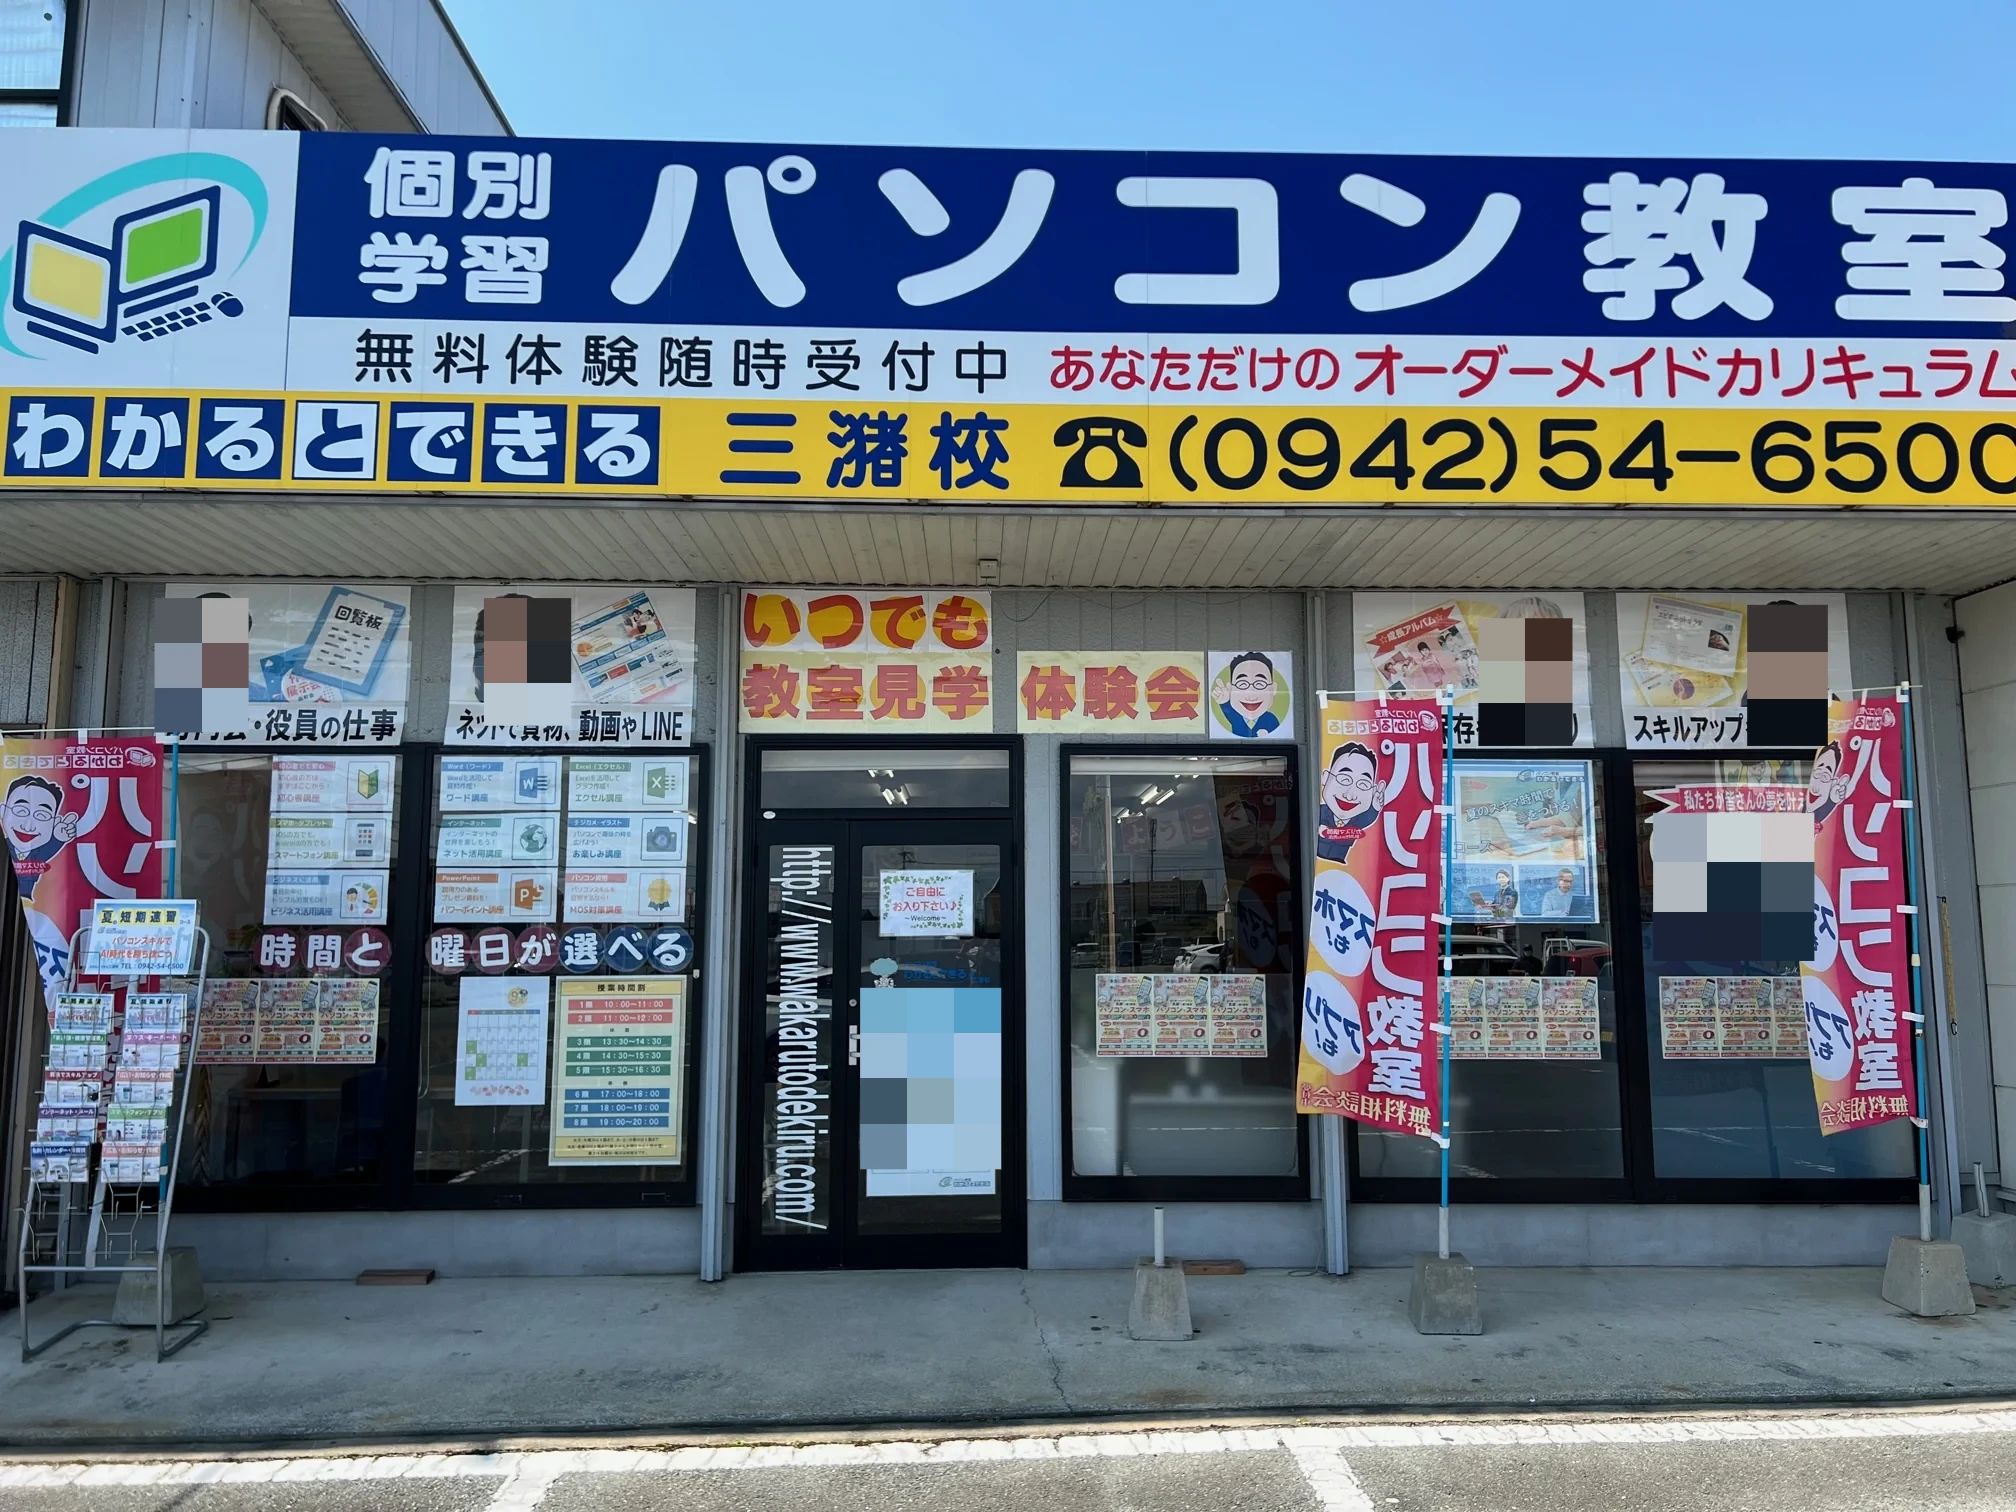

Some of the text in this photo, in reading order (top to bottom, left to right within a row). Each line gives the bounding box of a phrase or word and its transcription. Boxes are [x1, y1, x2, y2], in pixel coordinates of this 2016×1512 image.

[364, 146, 552, 220] 個別
[610, 155, 2016, 322] パソコン教室
[358, 231, 550, 305] 学習
[355, 328, 1007, 394] 無料体験随時受付中
[12, 403, 651, 478] わかるとできる
[335, 605, 384, 630] 回覧板
[743, 592, 988, 650] いつでも
[743, 664, 989, 720] 教室見学
[1021, 664, 1201, 721] 体験会
[1633, 712, 1748, 744] スキルアップ
[446, 794, 489, 802] ワード講座
[575, 794, 623, 802] エクセル講座
[443, 850, 502, 859] ネット活用講座
[572, 850, 622, 859] お楽しみ講座
[906, 887, 946, 897] ご自由に
[260, 932, 382, 969] 時間と
[431, 932, 687, 968] 曜日が選べる
[597, 984, 647, 993] 授業時間割
[769, 847, 833, 1230] http://www.wakarutodekiru.com/
